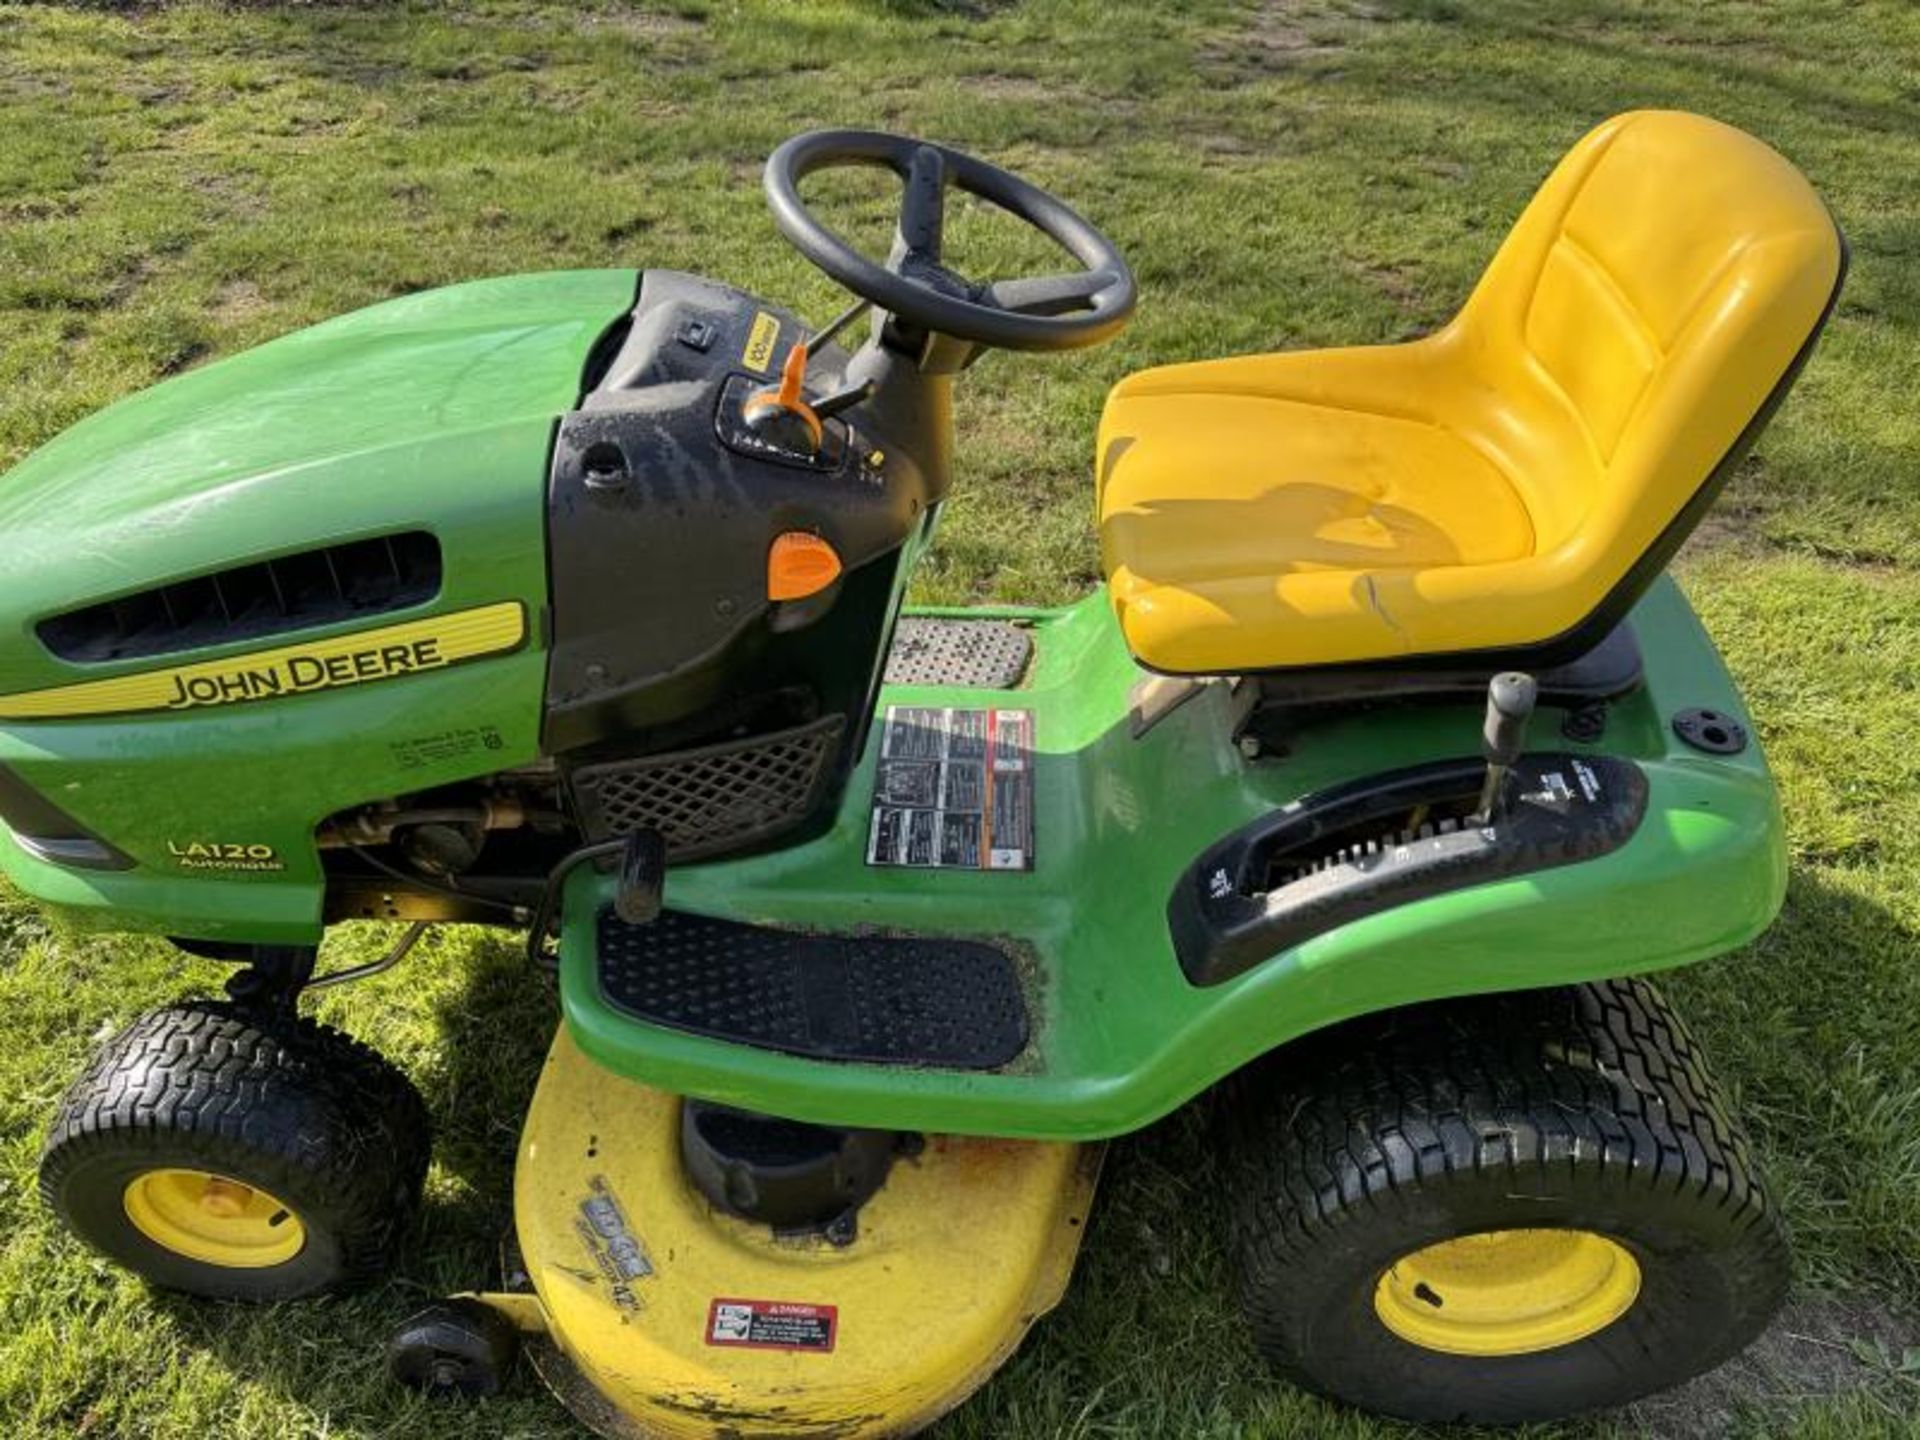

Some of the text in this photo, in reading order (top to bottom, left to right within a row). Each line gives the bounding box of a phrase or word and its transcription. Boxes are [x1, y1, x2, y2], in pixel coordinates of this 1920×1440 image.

[169, 638, 442, 704] JOHN DEERE
[168, 840, 272, 859] LA120
[181, 858, 284, 871] Automatic
